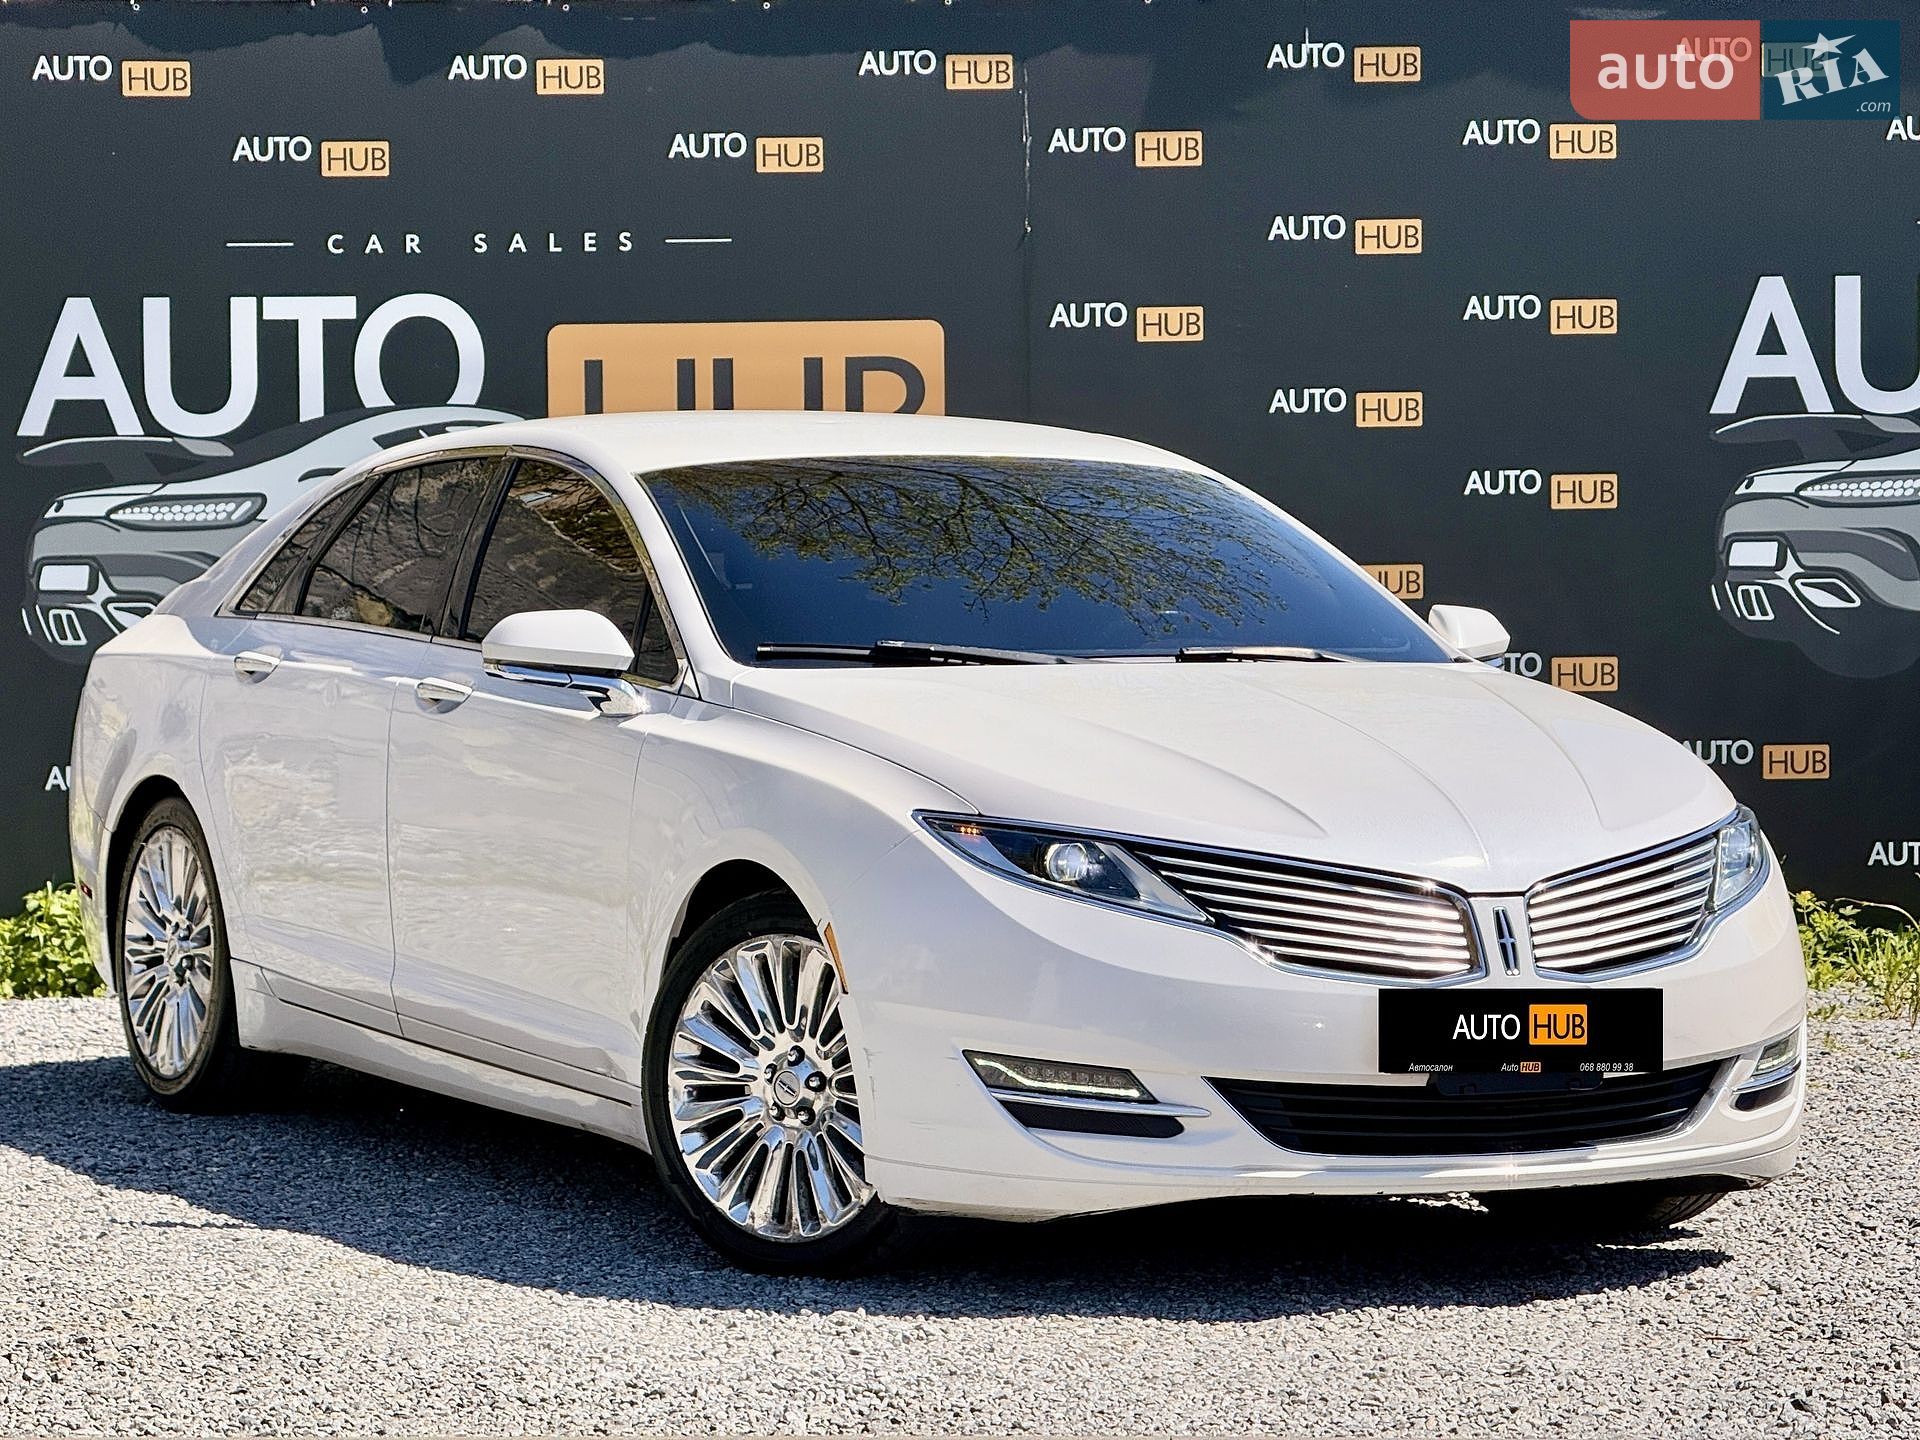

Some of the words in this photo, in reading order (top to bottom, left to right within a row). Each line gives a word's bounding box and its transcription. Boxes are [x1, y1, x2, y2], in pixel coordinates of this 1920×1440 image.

[32, 55, 112, 82] AUTO
[128, 67, 188, 92] HUB
[448, 54, 527, 81] AUTO
[542, 65, 602, 90] HUB
[858, 49, 937, 76] AUTO
[951, 60, 1011, 85] HUB
[1267, 43, 1345, 69] AUTO
[1360, 52, 1418, 78] HUB
[232, 135, 312, 162] AUTO
[327, 147, 387, 172] HUB
[669, 132, 747, 159] AUTO
[763, 143, 822, 168] HUB
[1048, 127, 1126, 154] AUTO
[1141, 136, 1200, 162] HUB
[1462, 119, 1541, 146] AUTO
[1556, 129, 1615, 154] HUB
[327, 233, 422, 255] CAR
[474, 231, 633, 254] SALES
[1268, 214, 1346, 241] AUTO
[1361, 224, 1420, 249] HUB
[1049, 301, 1127, 329] AUTO
[1143, 312, 1202, 337] HUB
[1463, 294, 1541, 321] AUTO
[1556, 305, 1616, 330] HUB
[17, 293, 486, 437] AUTO
[1268, 387, 1347, 414] AUTO
[1362, 397, 1421, 422] HUB
[1463, 469, 1542, 496] AUTO
[1557, 479, 1616, 505] HUB
[1558, 662, 1618, 688] HUB
[1768, 750, 1828, 775] HUB
